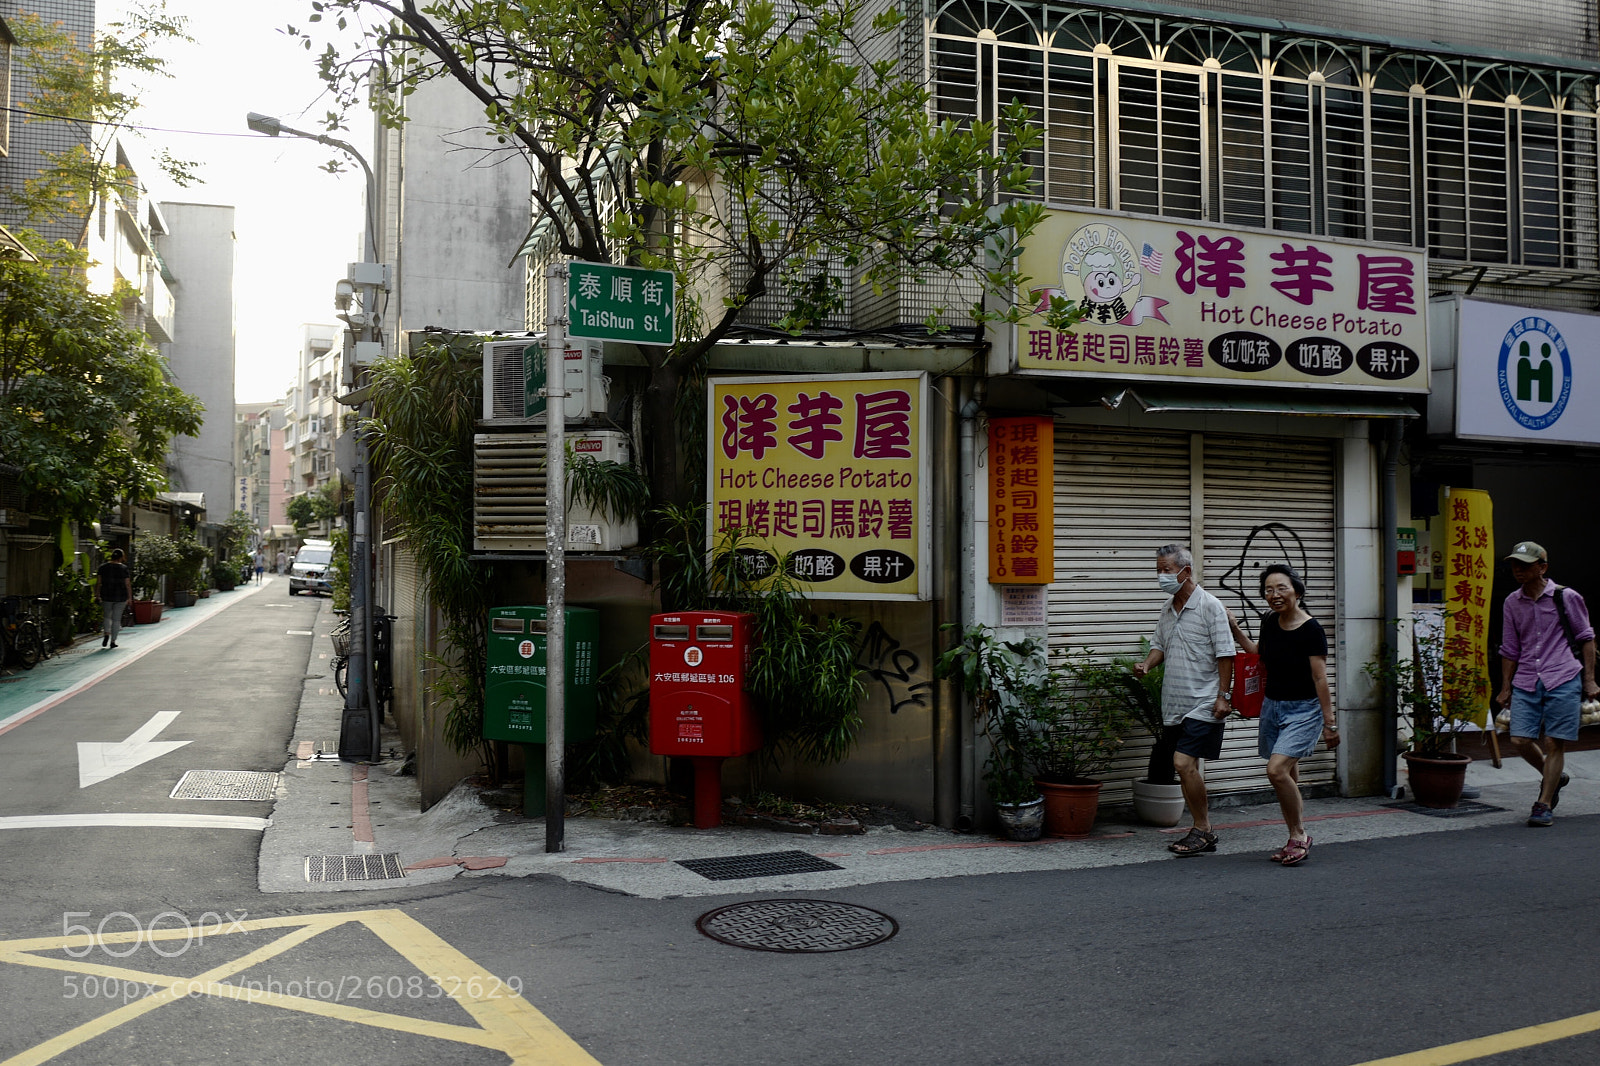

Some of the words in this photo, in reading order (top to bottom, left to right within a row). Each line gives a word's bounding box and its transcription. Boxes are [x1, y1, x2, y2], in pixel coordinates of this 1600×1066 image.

[1064, 228, 1101, 276] Potato
[1105, 227, 1136, 279] House
[578, 272, 664, 306] 泰順街
[1175, 230, 1417, 316] 洋芋屋
[580, 308, 634, 330] TaiShun
[644, 314, 662, 332] St.
[1201, 301, 1243, 325] Hot
[1250, 305, 1327, 332] Cheese
[1332, 313, 1403, 337] Potato
[1028, 329, 1205, 368] 現烤起司馬鈴薯
[1299, 343, 1343, 370] 奶酪
[1370, 348, 1411, 374] 果汁
[1499, 369, 1518, 418] NATIONAL
[1519, 413, 1546, 428] HEALTH
[1545, 375, 1571, 424] INSURANCE
[722, 390, 912, 460] 洋芋屋
[576, 442, 602, 450] SANYO
[994, 425, 1006, 499] Cheese
[720, 468, 757, 489] Hot
[762, 467, 834, 489] Cheese
[840, 467, 912, 489] Potato
[718, 498, 913, 540] 現烤起司馬鈴薯
[1010, 423, 1039, 577] 現烤起司馬鈴薯
[995, 504, 1007, 577] Potato
[795, 555, 835, 576] 奶酪
[863, 556, 904, 577] 果汁
[718, 674, 735, 684] 106
